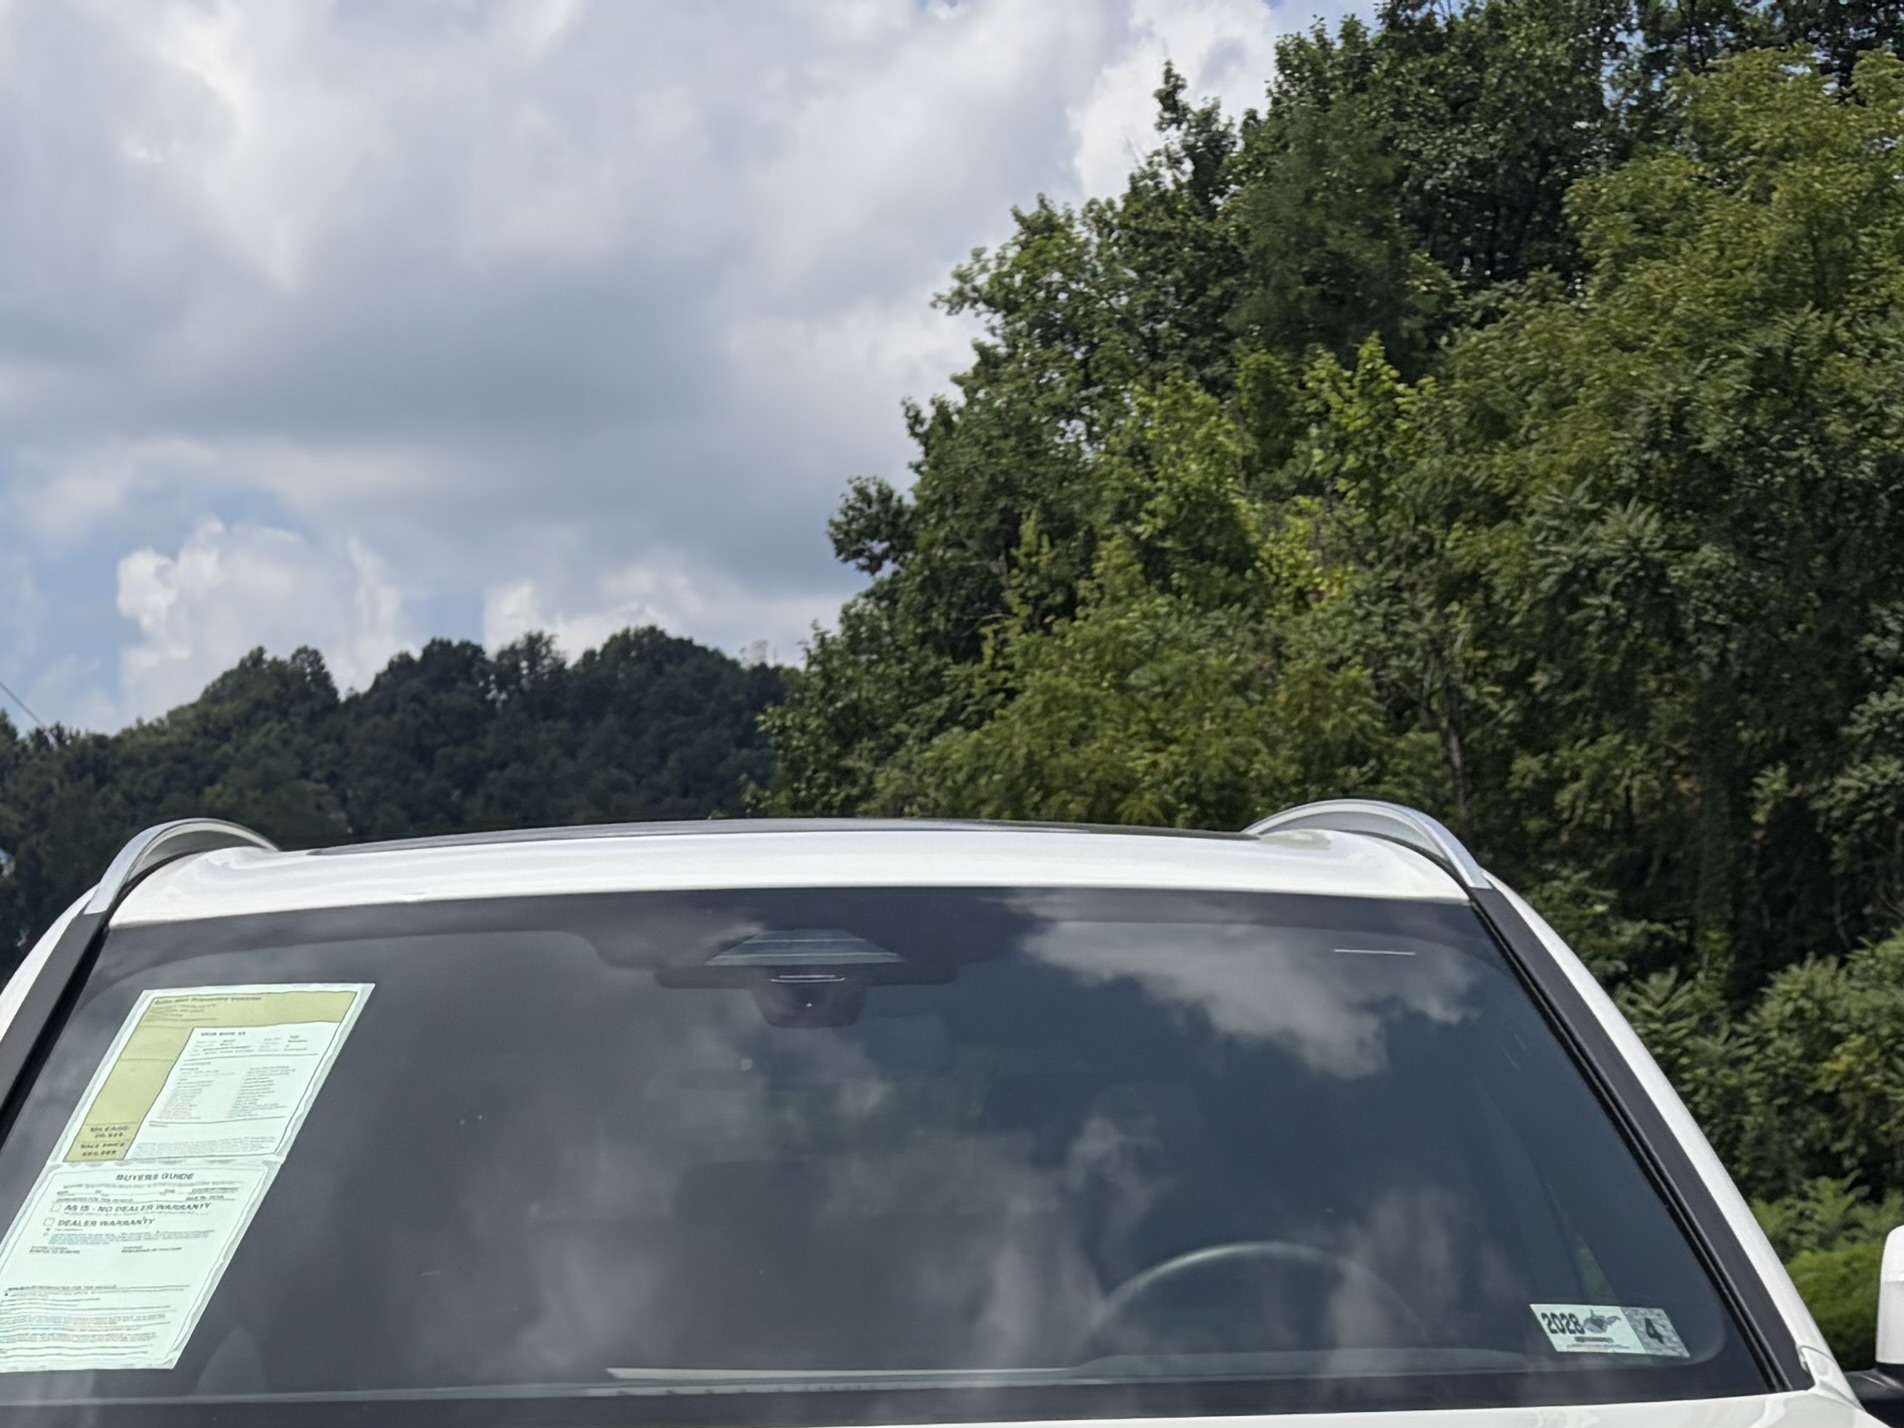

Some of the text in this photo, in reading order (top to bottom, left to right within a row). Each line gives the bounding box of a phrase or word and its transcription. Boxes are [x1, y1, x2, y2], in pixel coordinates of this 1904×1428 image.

[161, 1172, 195, 1180] GUIDE
[115, 1204, 155, 1212] DEALER
[156, 1202, 212, 1211] WARRANTY
[57, 1217, 156, 1227] DEALER WARRANTY
[1540, 1312, 1585, 1334] 2028
